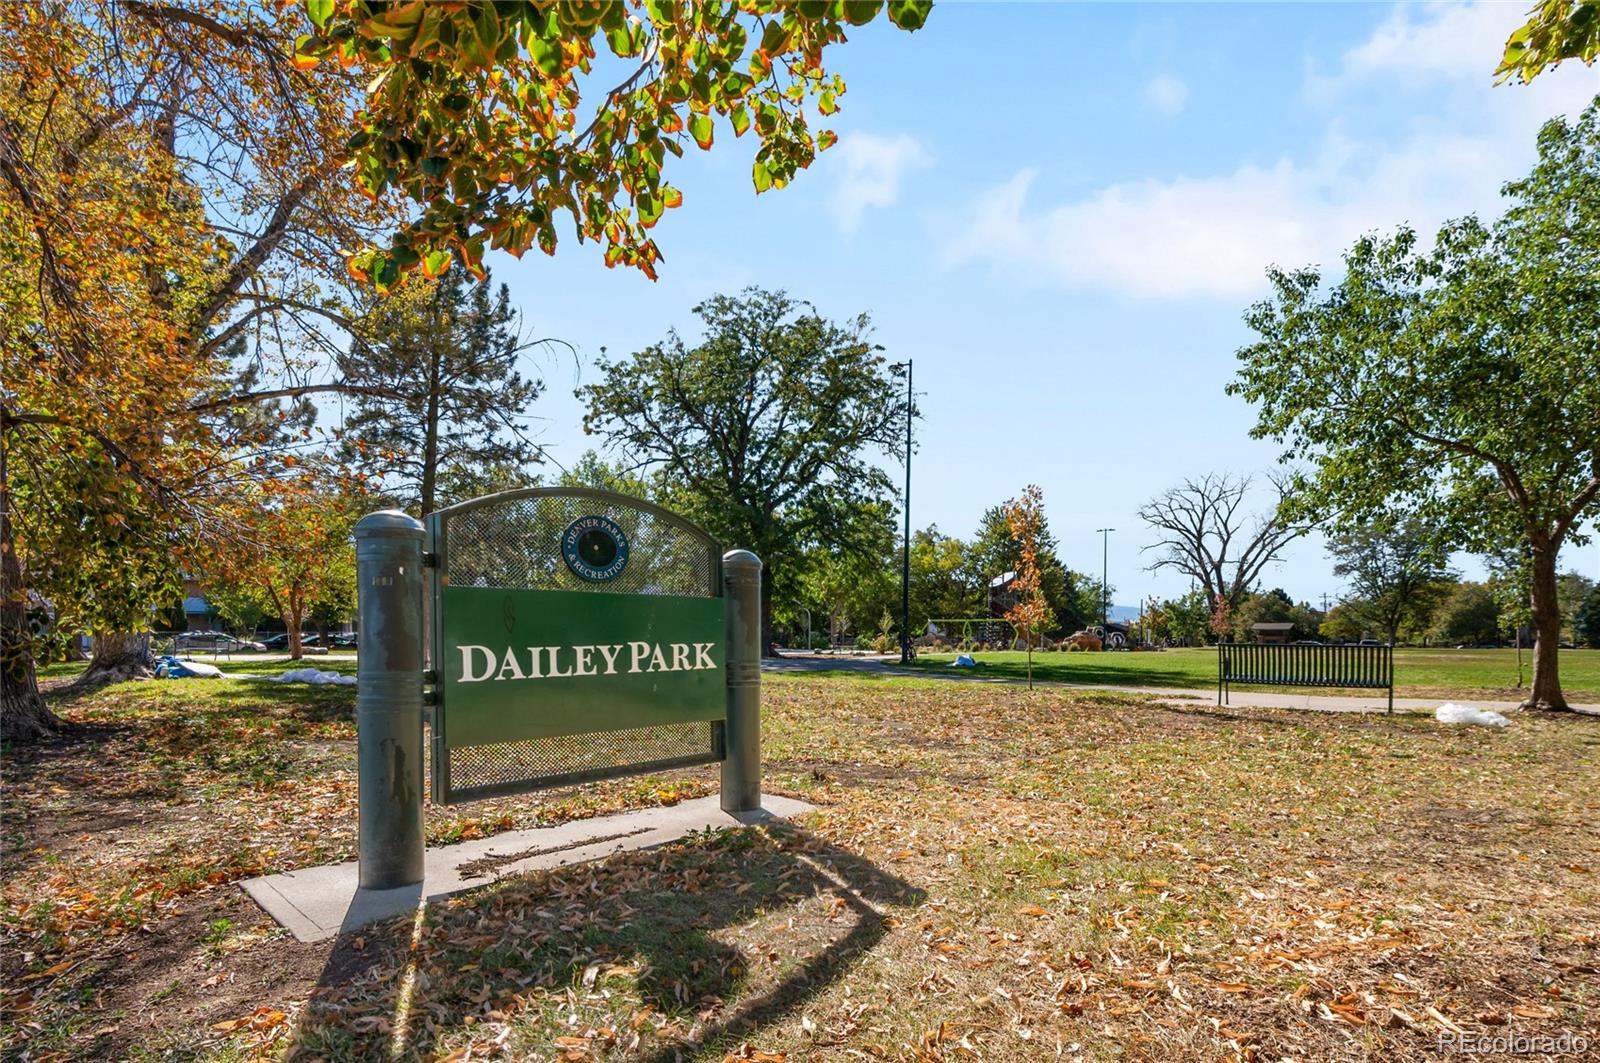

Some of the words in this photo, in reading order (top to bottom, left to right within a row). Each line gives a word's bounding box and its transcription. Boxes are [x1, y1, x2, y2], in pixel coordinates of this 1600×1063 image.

[567, 519, 599, 544] DENVER
[601, 520, 626, 547] PARKS
[568, 553, 576, 562] &
[573, 556, 625, 579] RECREATION
[456, 644, 624, 683] DAILEY
[627, 641, 718, 673] PARK
